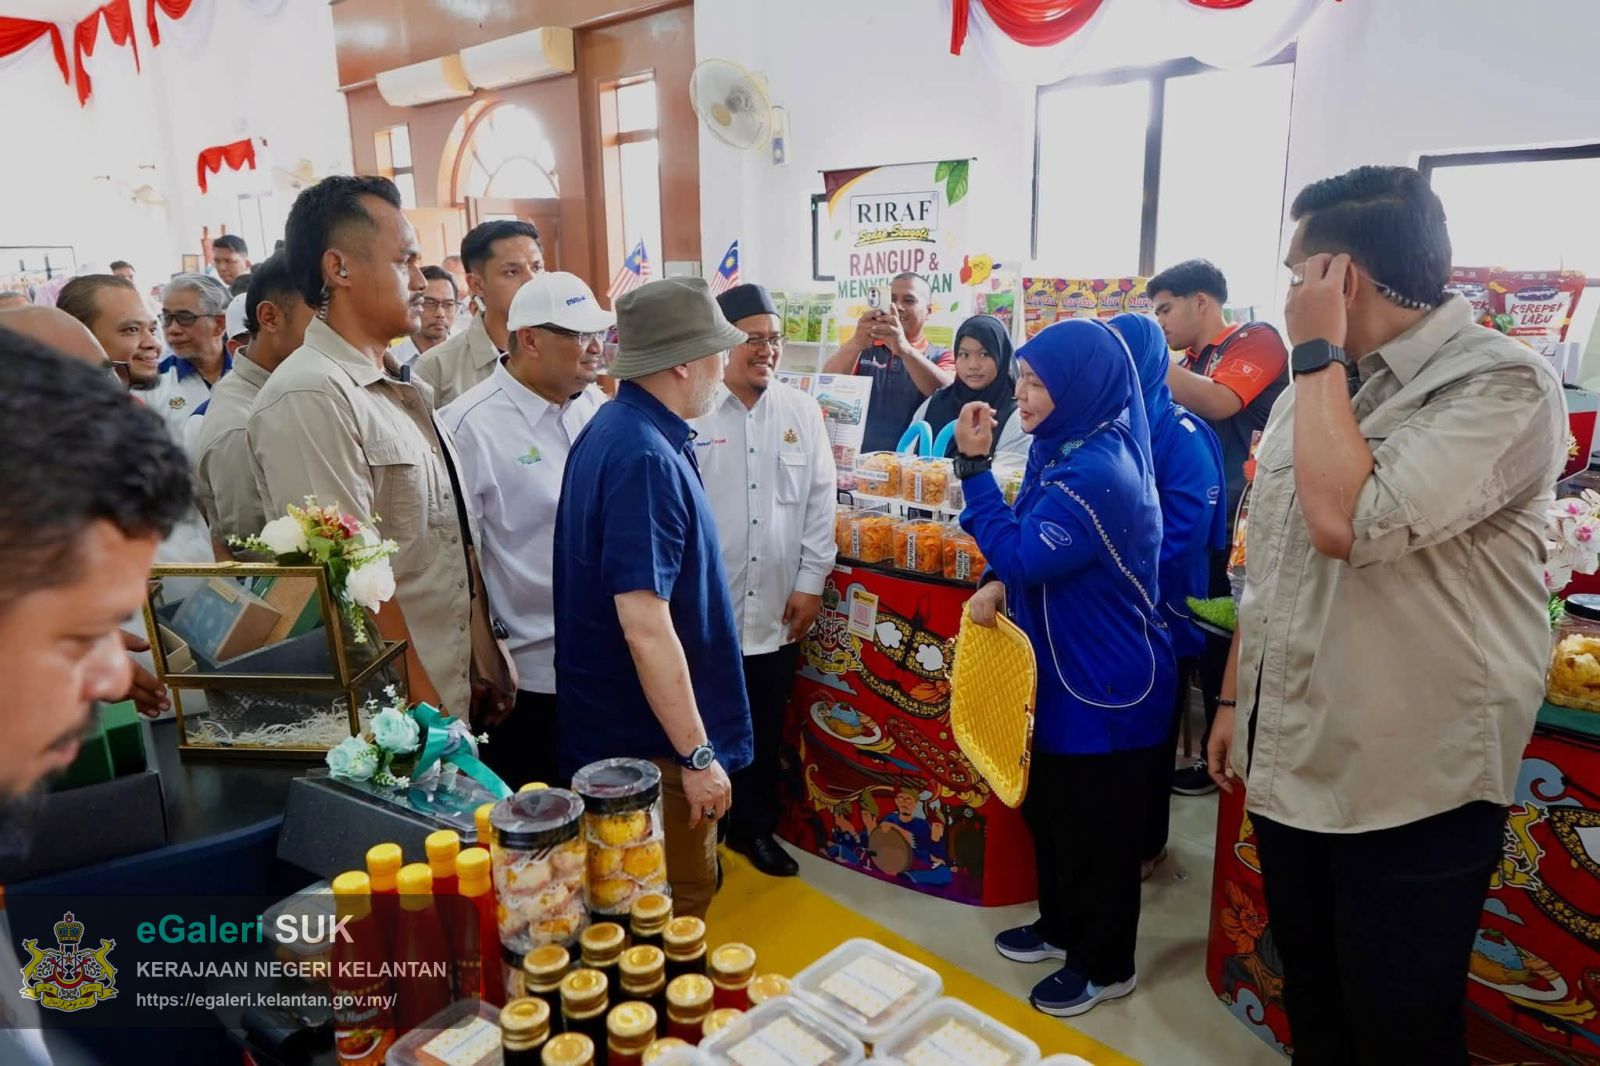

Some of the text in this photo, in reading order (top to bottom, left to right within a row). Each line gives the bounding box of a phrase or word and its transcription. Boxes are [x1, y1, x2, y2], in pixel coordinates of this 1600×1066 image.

[857, 200, 932, 223] RIRAF
[849, 248, 939, 277] RANGUP &
[1520, 313, 1553, 325] LABU
[907, 535, 915, 570] PAPRIKA
